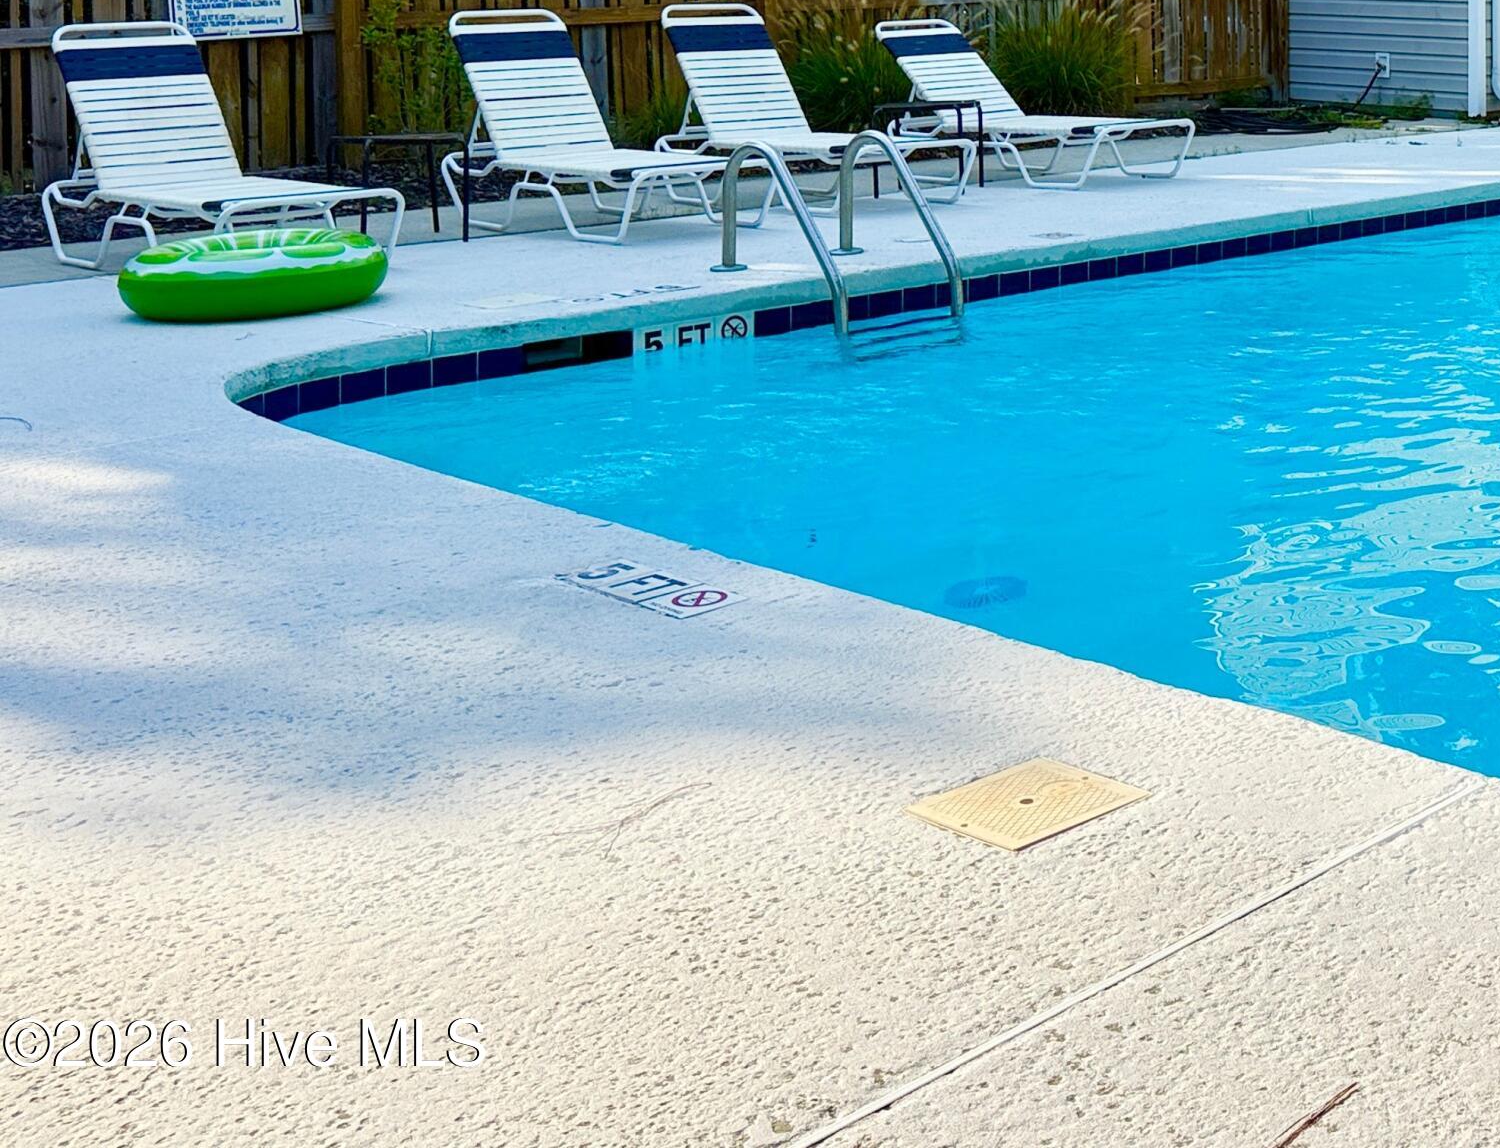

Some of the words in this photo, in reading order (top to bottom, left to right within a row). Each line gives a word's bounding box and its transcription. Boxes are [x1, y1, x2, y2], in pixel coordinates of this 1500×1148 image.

[645, 331, 663, 352] 5
[678, 323, 712, 347] FT
[577, 562, 636, 580] 5
[608, 574, 689, 596] FT
